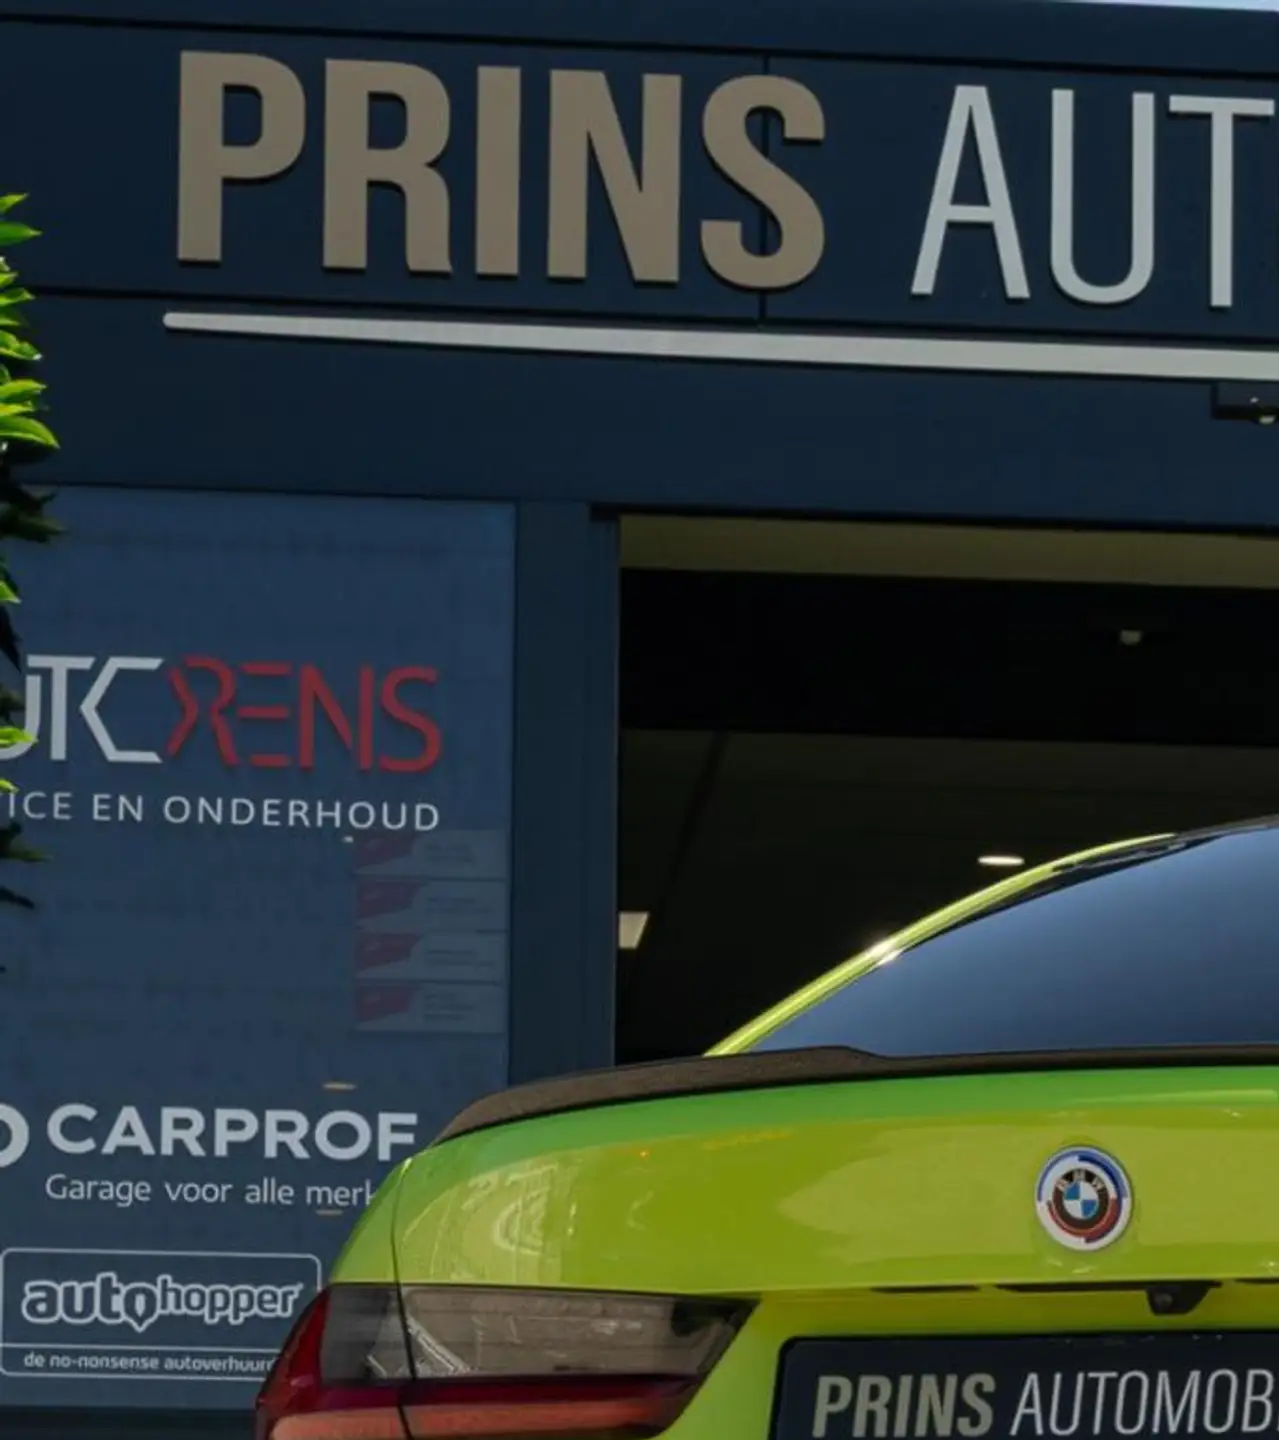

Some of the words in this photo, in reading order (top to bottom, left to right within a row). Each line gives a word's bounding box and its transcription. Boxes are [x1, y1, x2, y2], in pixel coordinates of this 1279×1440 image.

[176, 49, 826, 290] PRINS
[0, 791, 72, 820] ICE
[92, 793, 143, 822] EN
[163, 796, 440, 831] ONDERHOUD
[46, 1102, 418, 1162] CARPROF
[45, 1173, 152, 1207] Garage
[164, 1180, 233, 1203] voor
[244, 1177, 294, 1205] alle
[21, 1271, 304, 1333] autohopper
[24, 1353, 46, 1367] de
[49, 1355, 160, 1370] no-nonsense
[812, 1373, 996, 1439] PRINS
